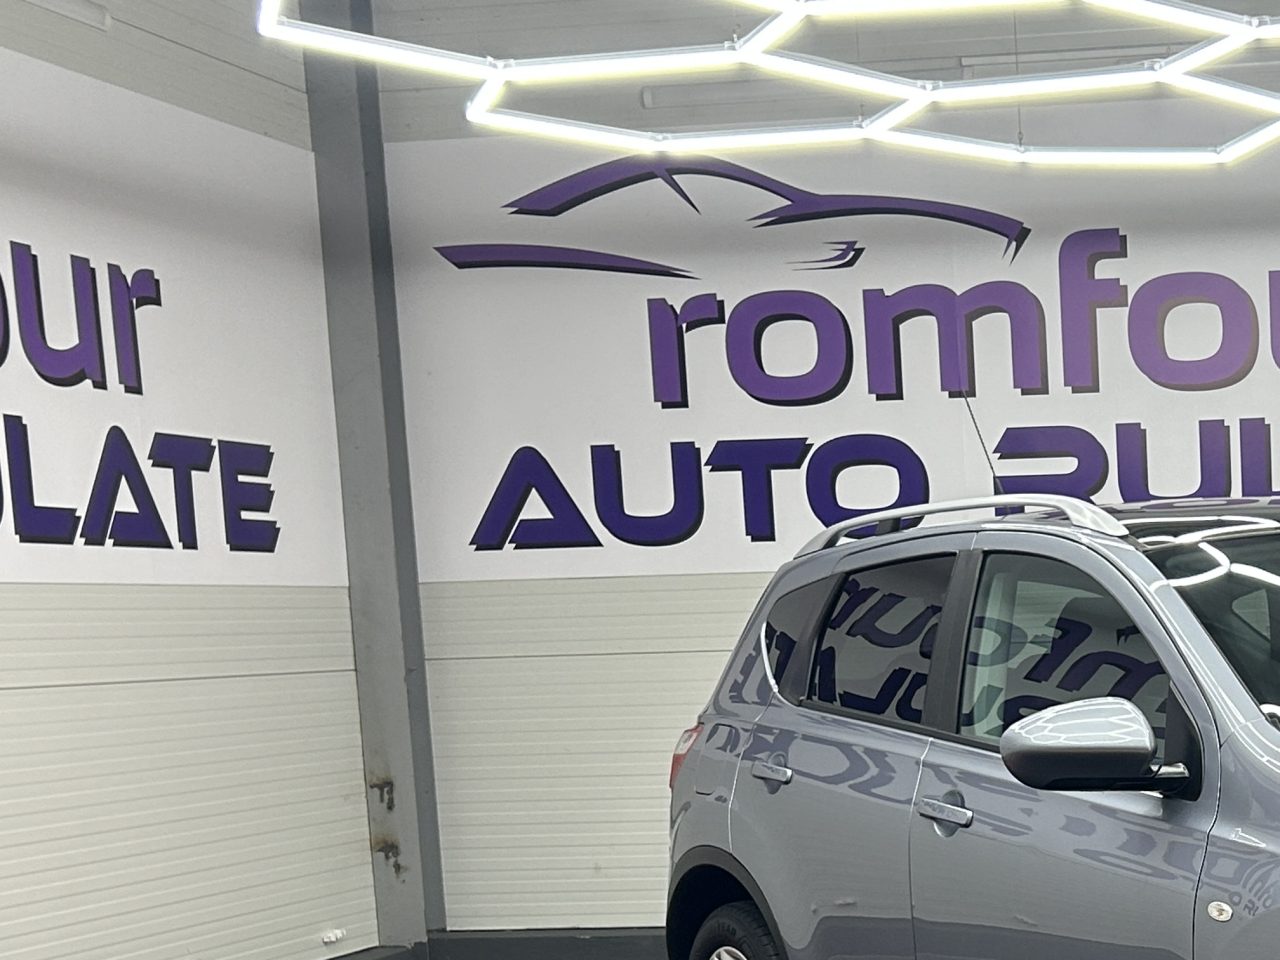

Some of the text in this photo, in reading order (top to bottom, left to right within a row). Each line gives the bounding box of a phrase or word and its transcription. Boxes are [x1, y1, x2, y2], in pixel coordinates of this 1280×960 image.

[0, 240, 162, 396] ur
[0, 413, 281, 553] LATE
[469, 433, 930, 552] AUTO
